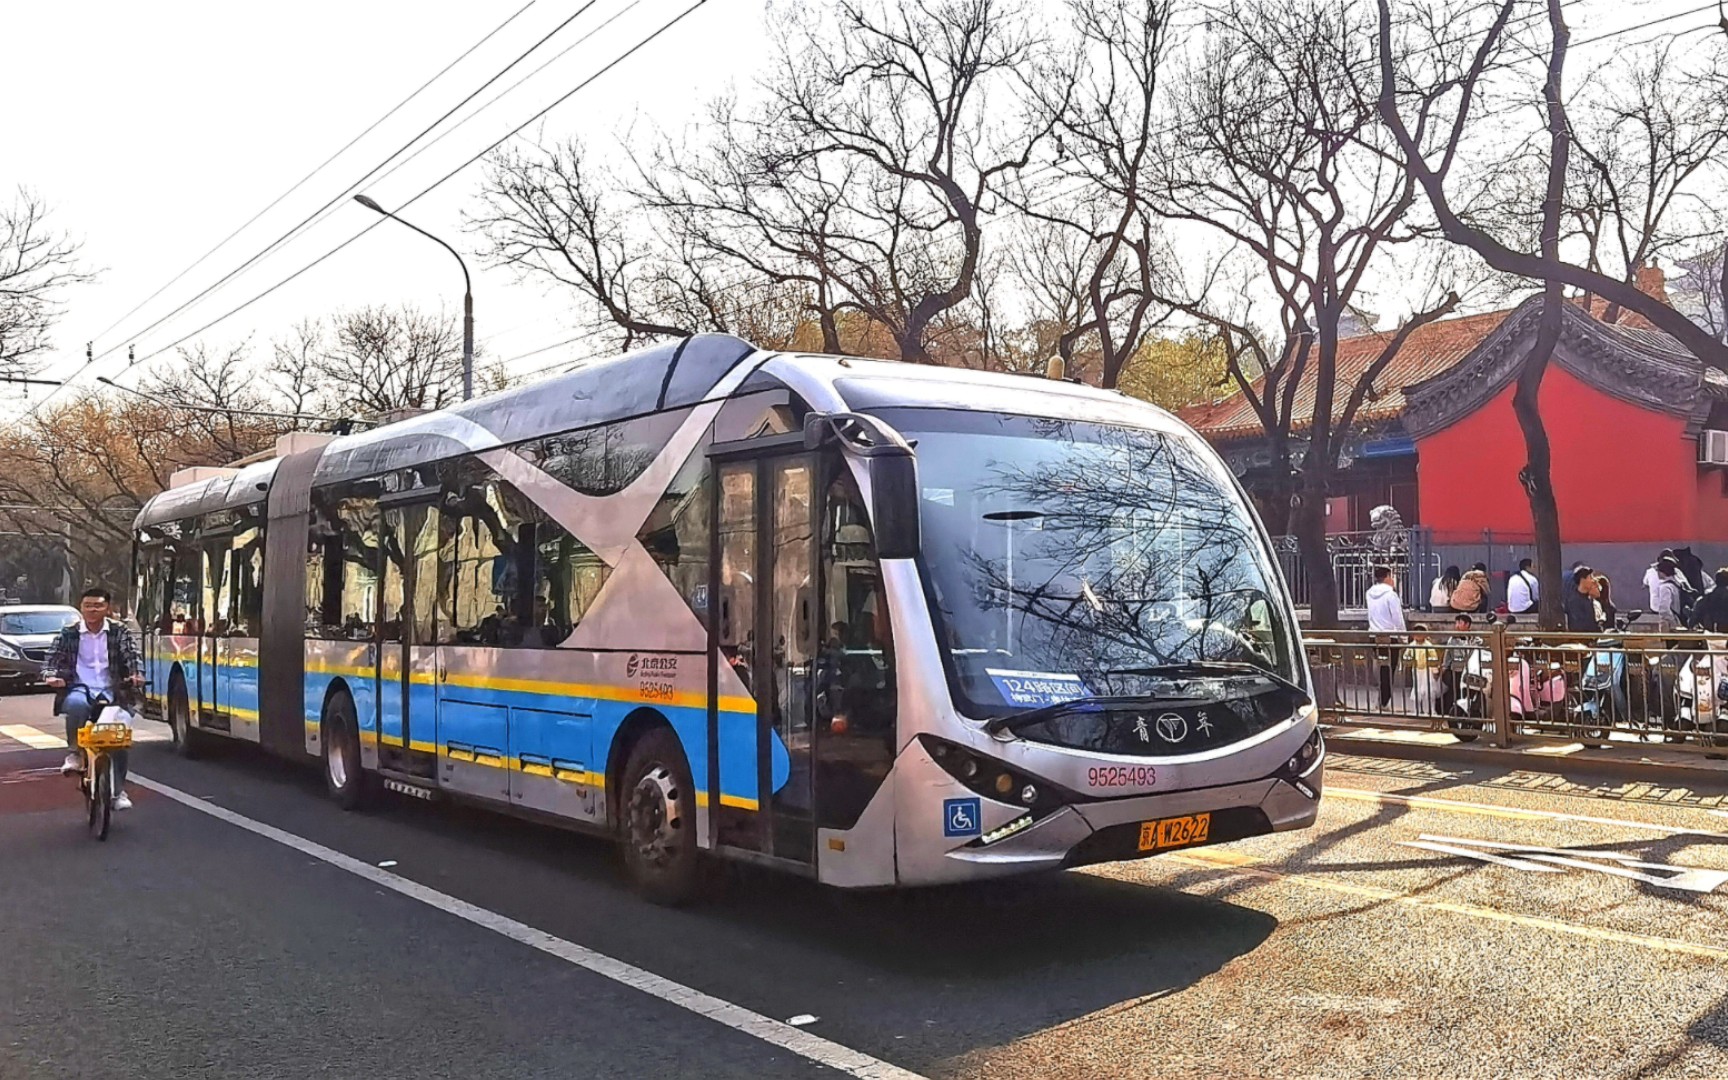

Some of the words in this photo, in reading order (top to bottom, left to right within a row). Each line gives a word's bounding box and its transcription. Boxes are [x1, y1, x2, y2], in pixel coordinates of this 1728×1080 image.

[640, 657, 678, 670] 北京公交
[640, 681, 674, 700] 9525493
[1002, 679, 1085, 696] 124路区间
[1132, 715, 1149, 743] 青
[1196, 711, 1214, 738] 年
[1088, 766, 1156, 787] 9525493
